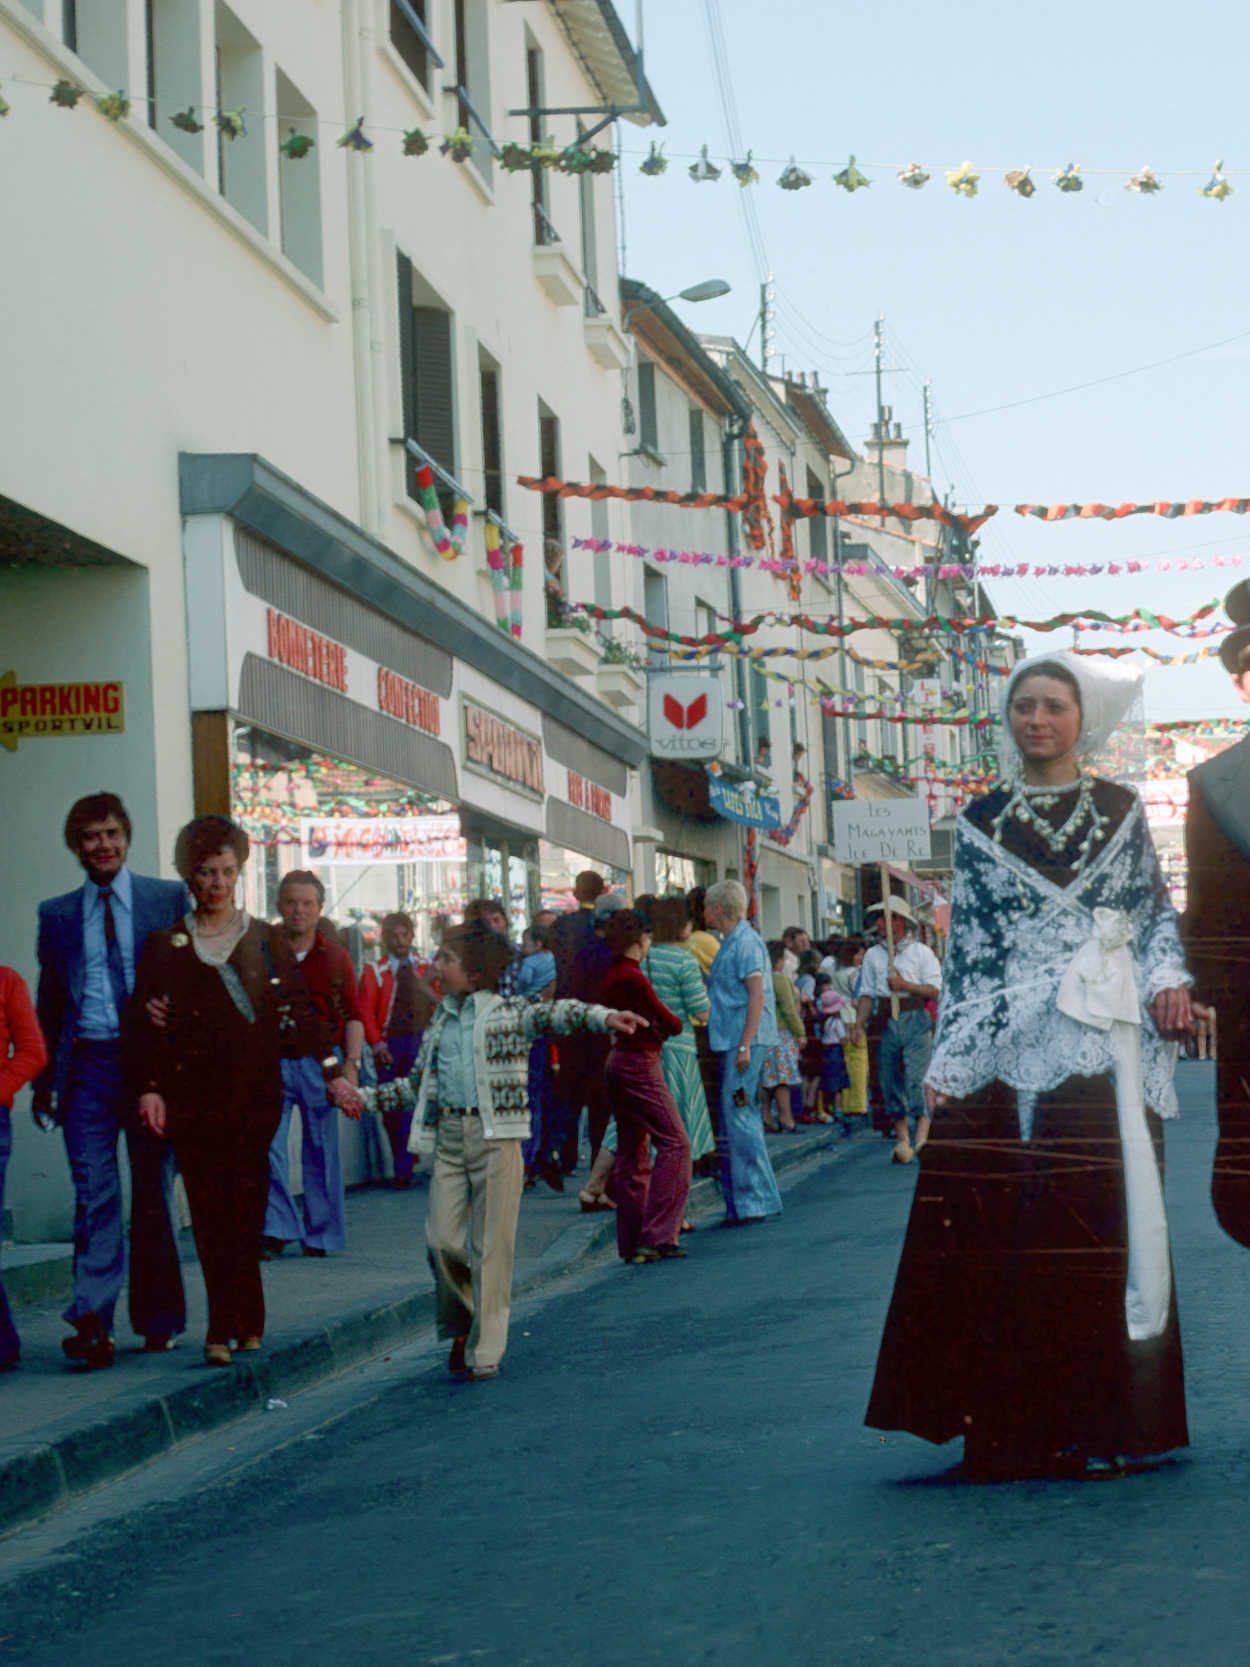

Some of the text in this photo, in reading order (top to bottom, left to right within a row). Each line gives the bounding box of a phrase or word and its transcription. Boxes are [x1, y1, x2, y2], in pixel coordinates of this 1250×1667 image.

[267, 607, 348, 693] BONNETERIE
[1, 683, 119, 717] PARKING
[2, 717, 119, 734] SPORTVIL
[656, 733, 717, 751] vitos
[868, 801, 891, 818] LES
[847, 823, 927, 841] MAGAYANTS
[848, 842, 867, 859] ILE
[880, 841, 898, 858] DE
